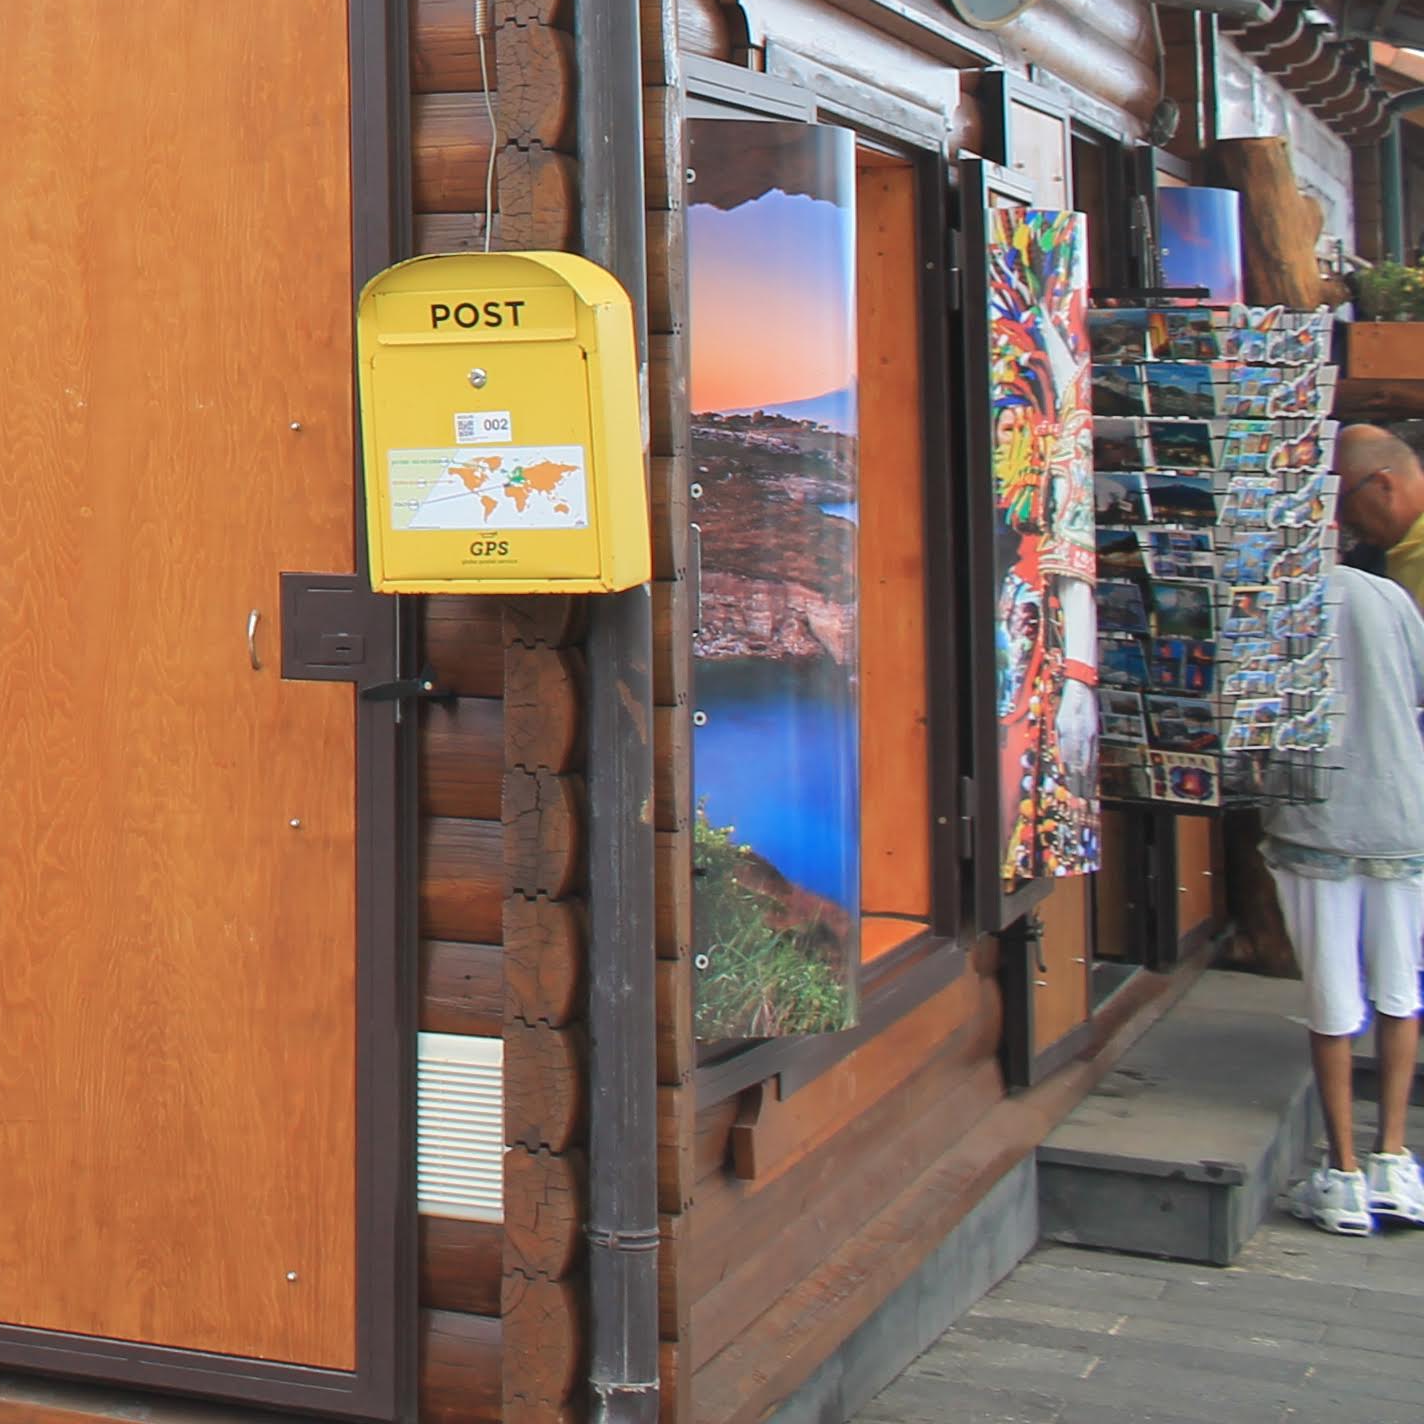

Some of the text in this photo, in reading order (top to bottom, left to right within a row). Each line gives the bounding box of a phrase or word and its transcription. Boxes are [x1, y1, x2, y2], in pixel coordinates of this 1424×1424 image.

[430, 300, 525, 329] POST
[483, 418, 509, 431] 002
[469, 540, 509, 557] GPS
